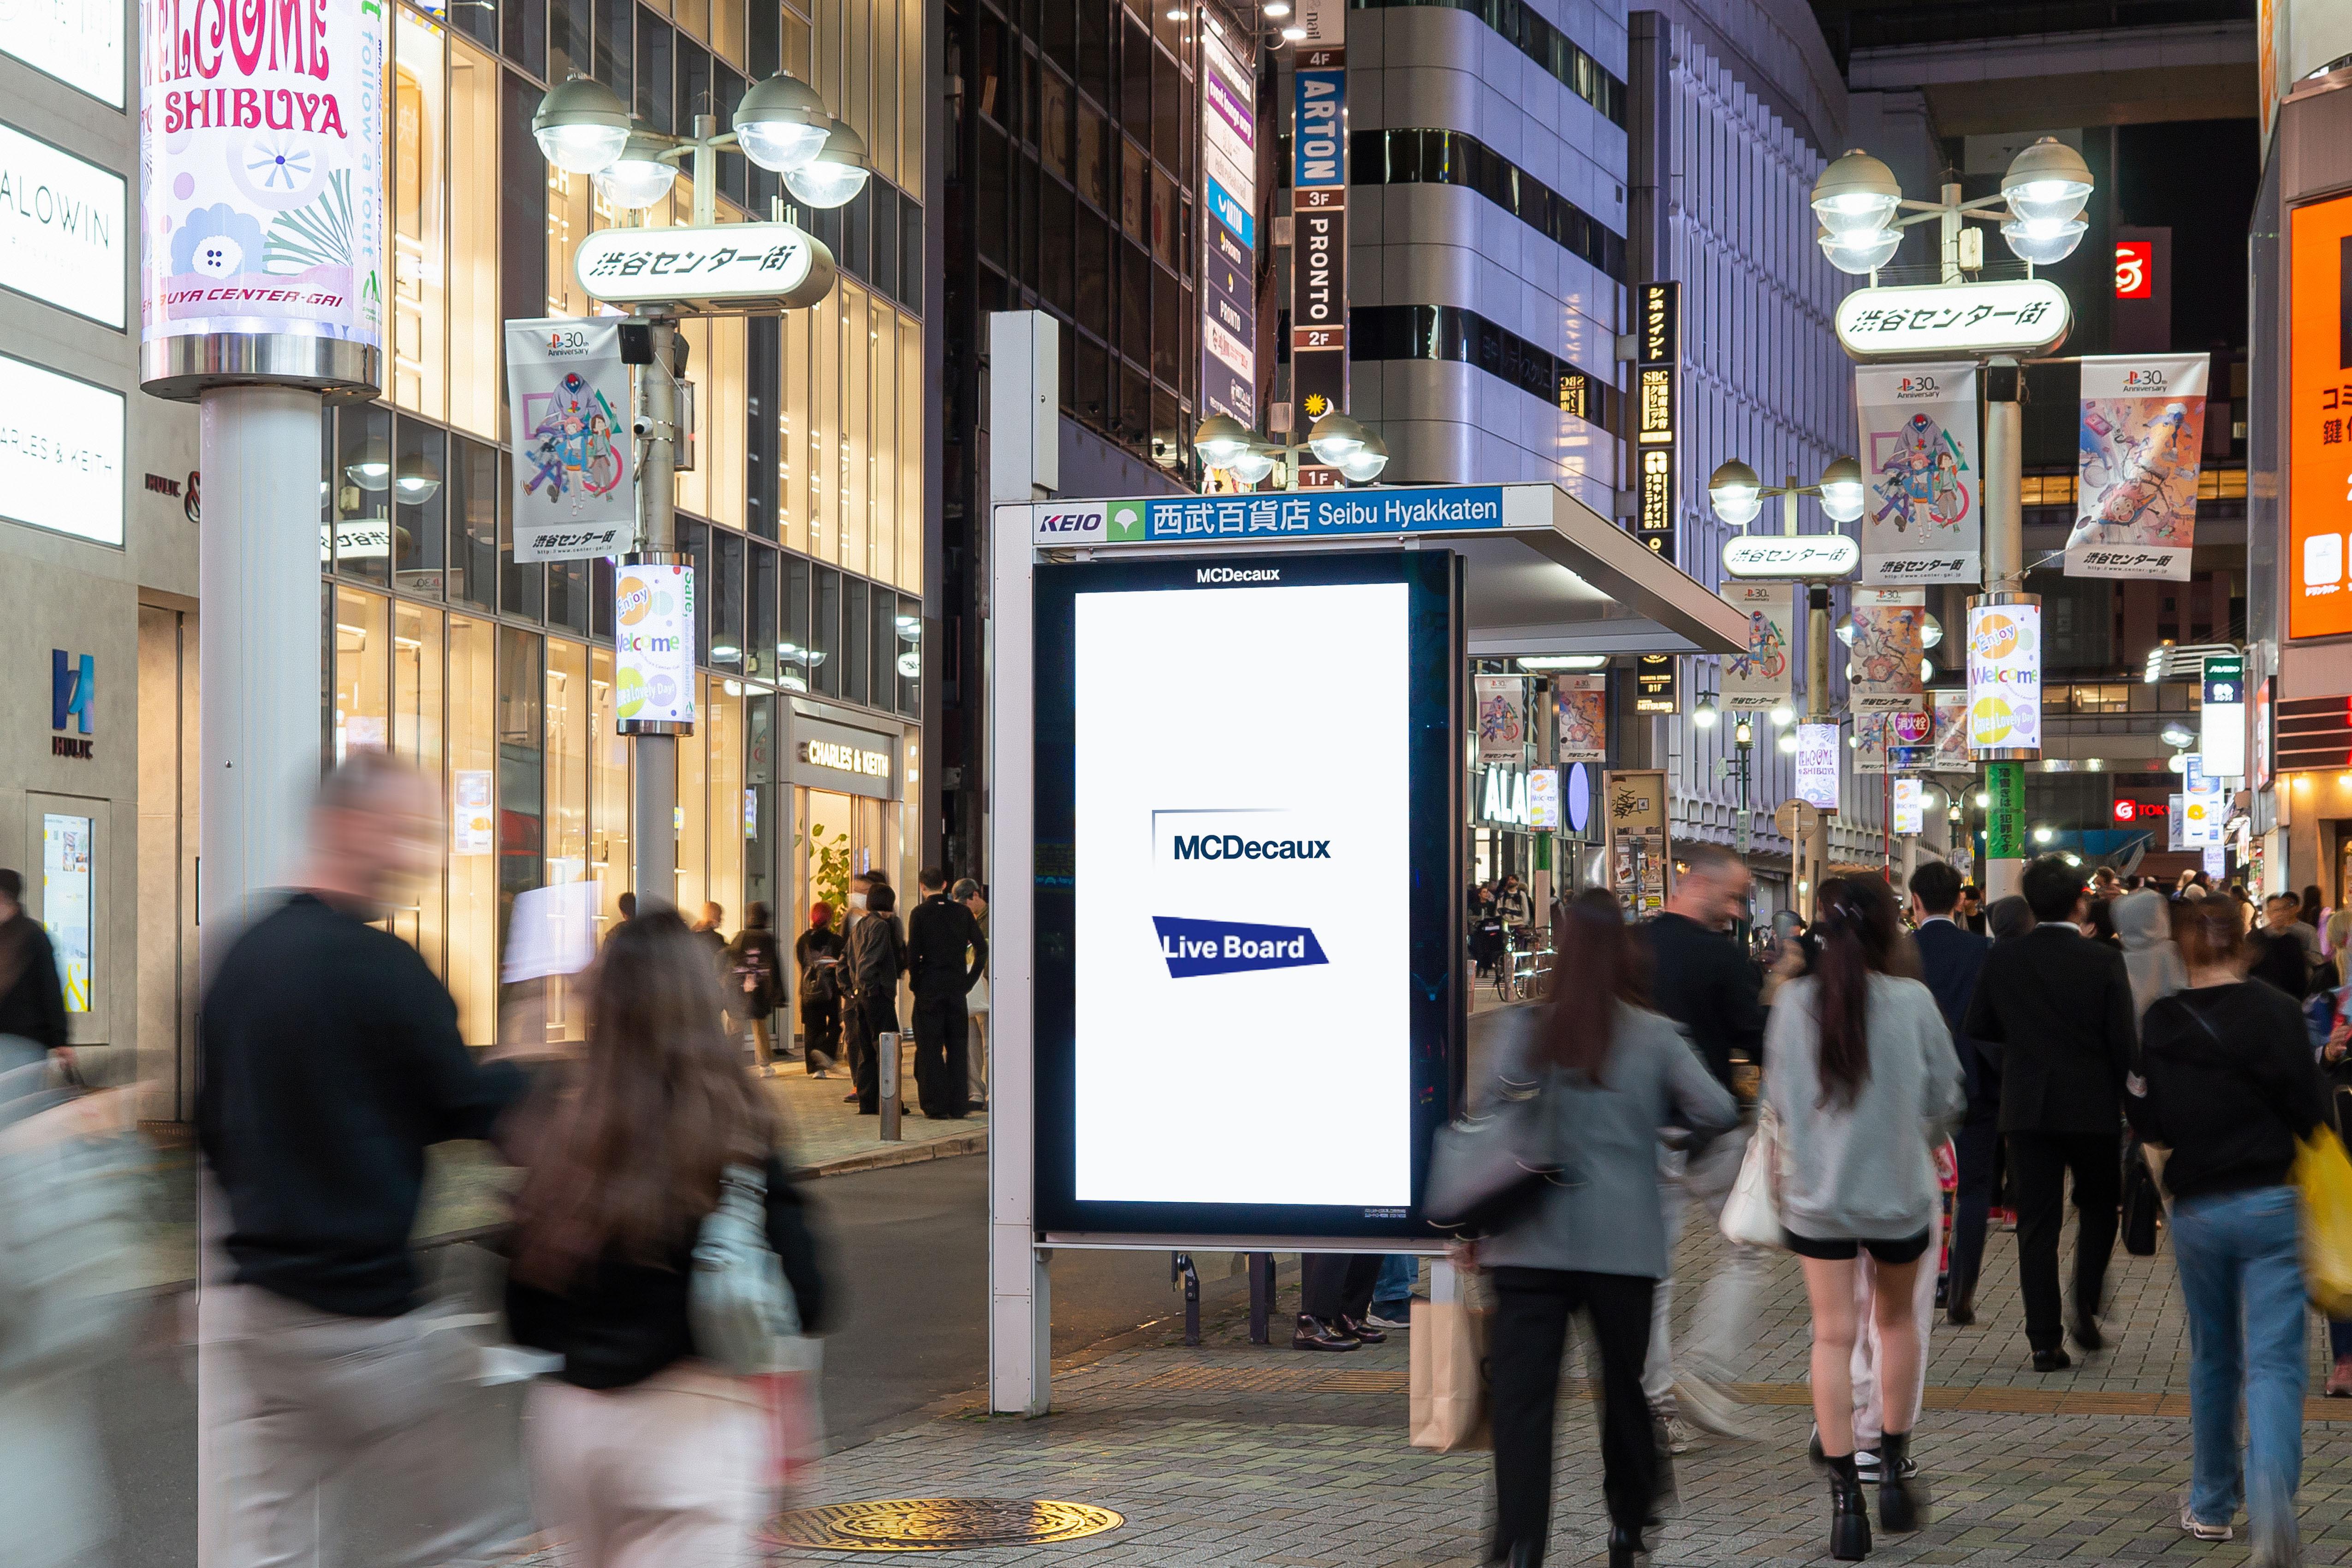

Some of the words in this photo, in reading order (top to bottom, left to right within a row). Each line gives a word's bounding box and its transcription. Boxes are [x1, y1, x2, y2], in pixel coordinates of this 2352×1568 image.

[1306, 12, 1321, 40] nail
[1310, 52, 1330, 65] 4F
[362, 30, 374, 143] follow
[166, 88, 347, 138] SHIBUYA
[1304, 80, 1336, 179] ARTON
[362, 153, 371, 171] a
[1309, 192, 1330, 206] 3F
[362, 186, 373, 257] tout
[589, 244, 796, 277] 渋谷センター街
[1310, 218, 1329, 320] PRONTO
[207, 288, 343, 308] CENTER-GAI
[1220, 299, 1241, 333] PRONTO
[1648, 287, 1665, 360] シネクイント
[1849, 301, 2052, 332] 渋谷センター街
[1309, 331, 1330, 346] 2F
[548, 347, 589, 356] Anniversary
[1643, 371, 1668, 382] SBC
[1897, 390, 1940, 400] Anniversary
[1308, 471, 1329, 486] 1F
[1039, 514, 1102, 532] KEIO
[1153, 500, 1311, 535] 西武百貨店
[1319, 502, 1378, 525] Seibu
[1385, 499, 1497, 529] Hyakkaten
[532, 530, 617, 548] 渋谷センター街
[1731, 547, 1850, 562] 渋谷センター街
[1880, 558, 1966, 573] 渋谷センター街
[2084, 551, 2174, 567] 渋谷センター街
[1196, 567, 1280, 583] MCDecaux
[617, 588, 647, 618] Enjoy
[1976, 625, 2014, 652] Enjoy
[1972, 665, 2037, 685] Welcome
[1897, 716, 1927, 731] 消火栓
[809, 740, 853, 771] CHARLES
[854, 748, 861, 772] &
[863, 751, 889, 778] KEITH
[1174, 835, 1331, 860] MCDecaux
[1163, 935, 1218, 958] Live
[1223, 935, 1305, 959] Board
